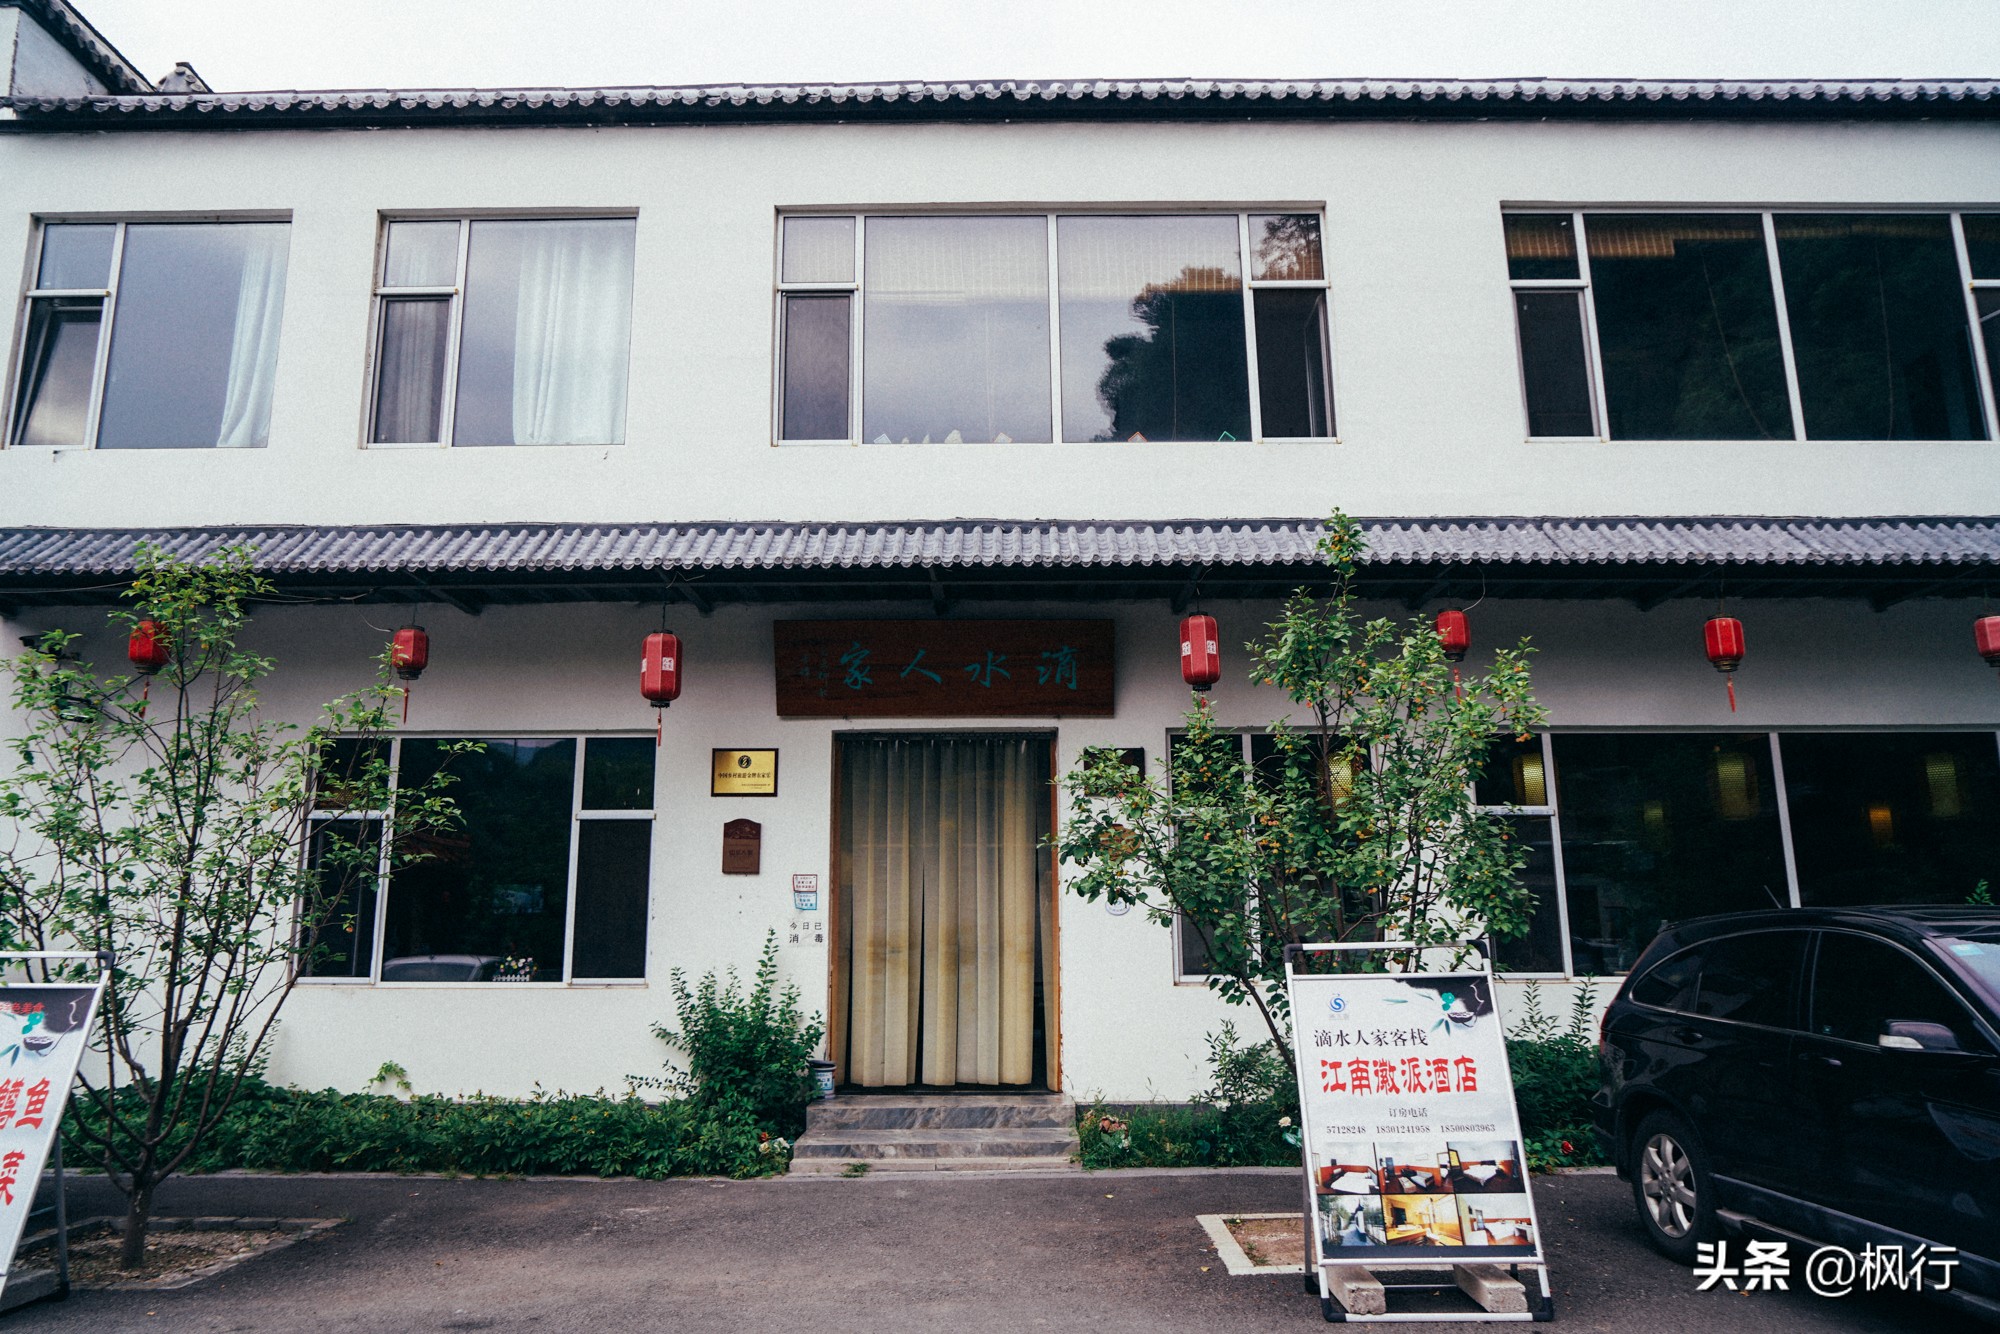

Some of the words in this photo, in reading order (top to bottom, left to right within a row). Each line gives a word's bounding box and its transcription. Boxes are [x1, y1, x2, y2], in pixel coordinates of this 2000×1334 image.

[839, 641, 1078, 690] 滴水人家
[790, 922, 823, 931] 今日已
[789, 933, 824, 944] 消毒
[1314, 1028, 1429, 1047] 滴水人家客栈
[1321, 1055, 1478, 1097] 江南徽派酒店
[1388, 1107, 1429, 1118] 订房电话
